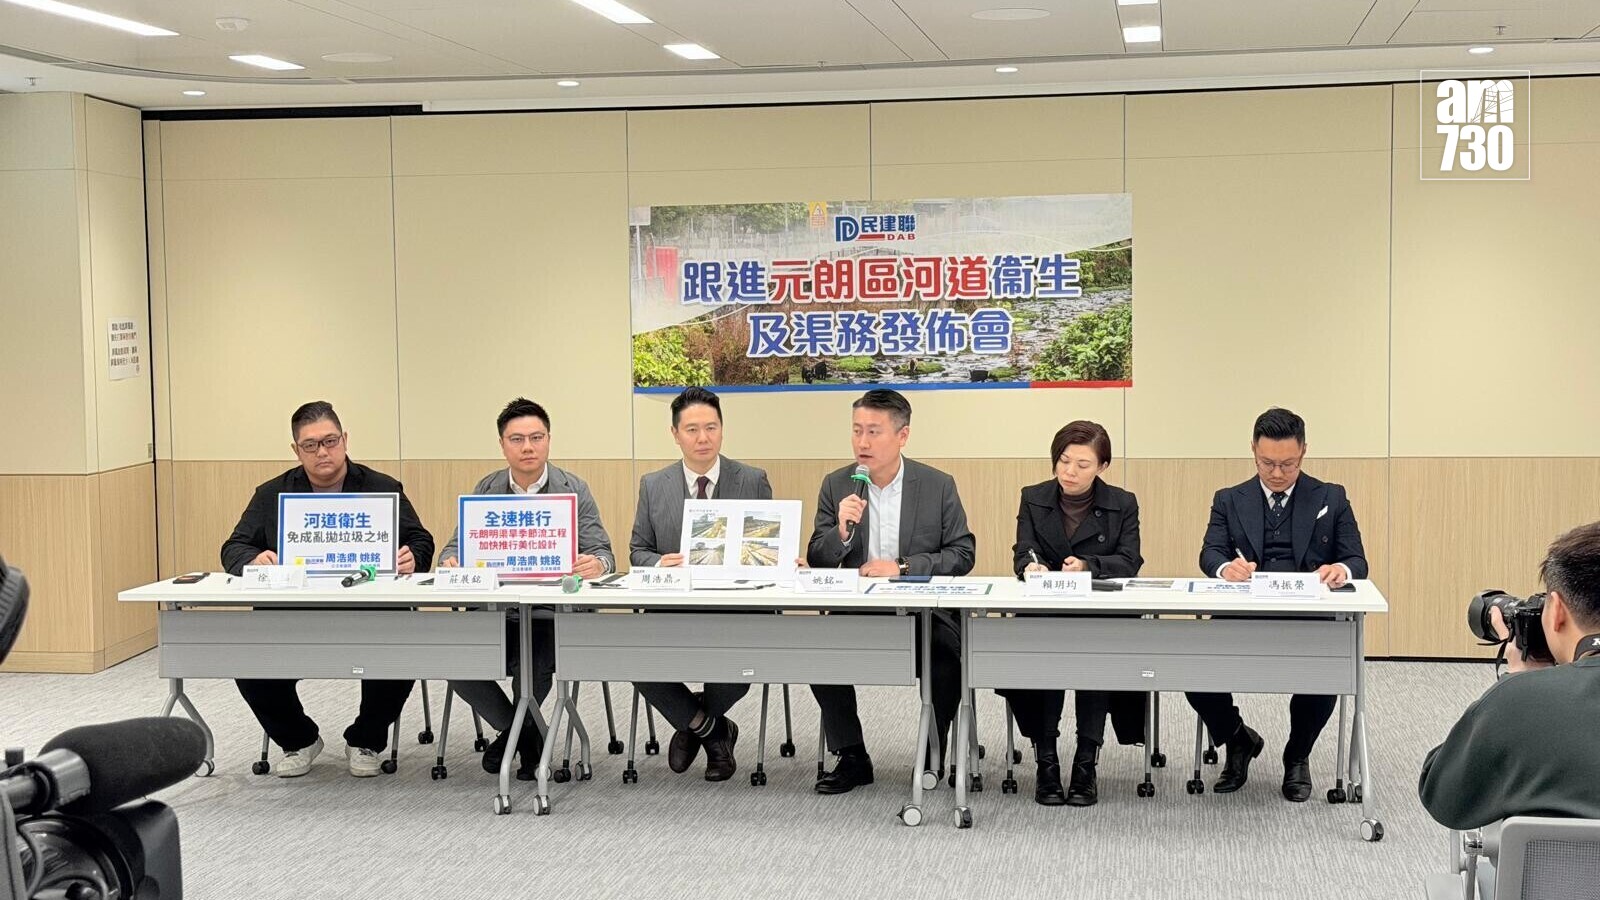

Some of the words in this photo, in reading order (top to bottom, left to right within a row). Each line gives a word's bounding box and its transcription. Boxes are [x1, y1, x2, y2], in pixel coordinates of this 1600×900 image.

[861, 214, 916, 232] 民建聯
[887, 233, 916, 241] DAB
[748, 310, 1012, 356] 及渠務發佈會
[484, 510, 552, 528] 全速推行
[469, 528, 567, 539] 元朗明渠旱季節流工程
[478, 540, 557, 551] 加快推行美化設計
[359, 552, 381, 563] 姚銘
[506, 555, 538, 566] 周浩鼎
[540, 555, 561, 566] 姚銘
